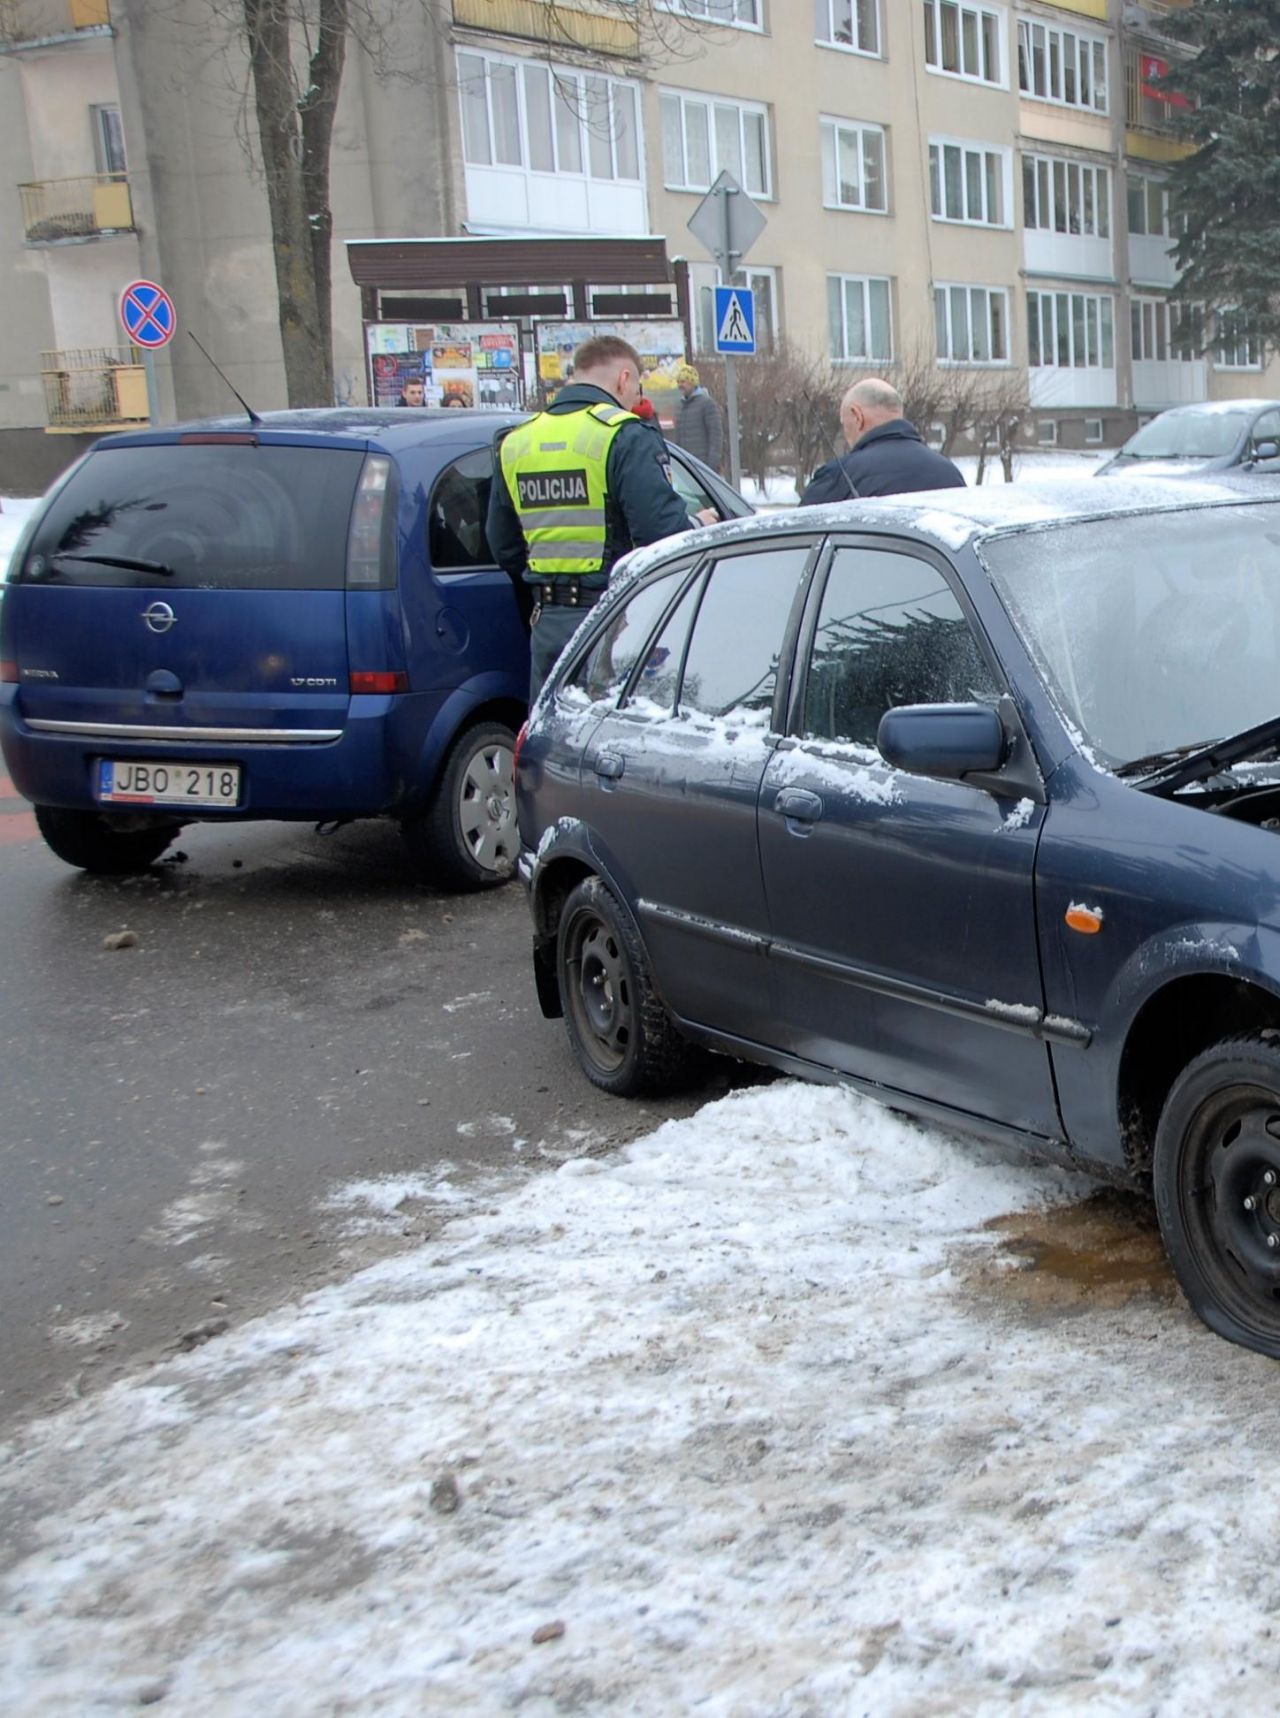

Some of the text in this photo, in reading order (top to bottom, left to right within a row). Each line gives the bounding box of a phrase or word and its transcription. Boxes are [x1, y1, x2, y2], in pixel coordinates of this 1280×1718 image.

[518, 476, 587, 502] POLICIJA
[306, 677, 337, 686] CDTI
[116, 765, 233, 797] JBO 218
